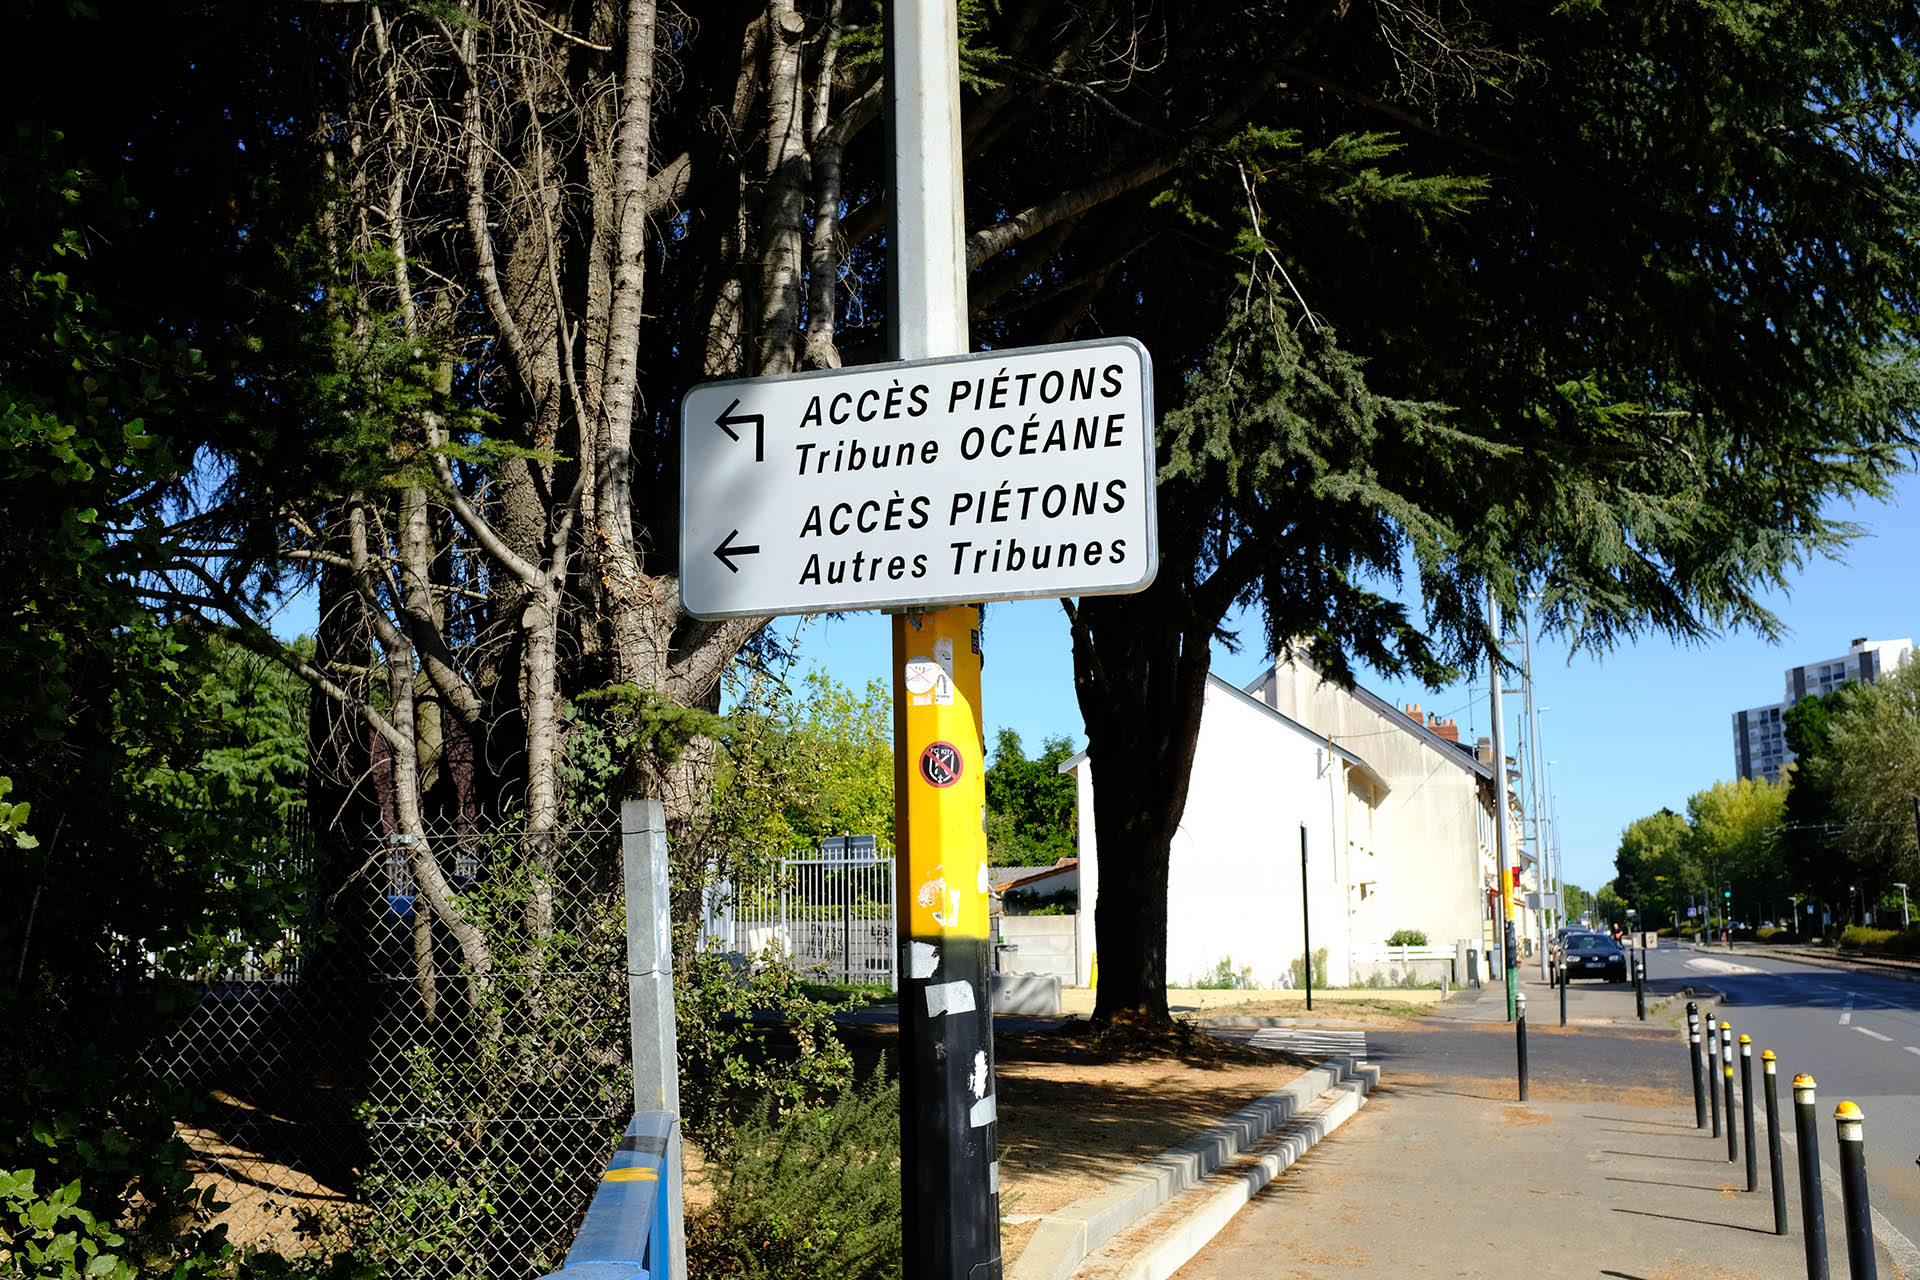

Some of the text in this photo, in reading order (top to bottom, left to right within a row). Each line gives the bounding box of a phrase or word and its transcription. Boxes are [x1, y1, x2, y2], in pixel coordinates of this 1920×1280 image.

[800, 364, 1124, 428] ACCÈS PIÉTONS
[796, 413, 1126, 476] Tribune OCÉANE
[799, 479, 1127, 538] ACCÈS PIÉTONS
[799, 539, 1127, 585] Autres Tribunes
